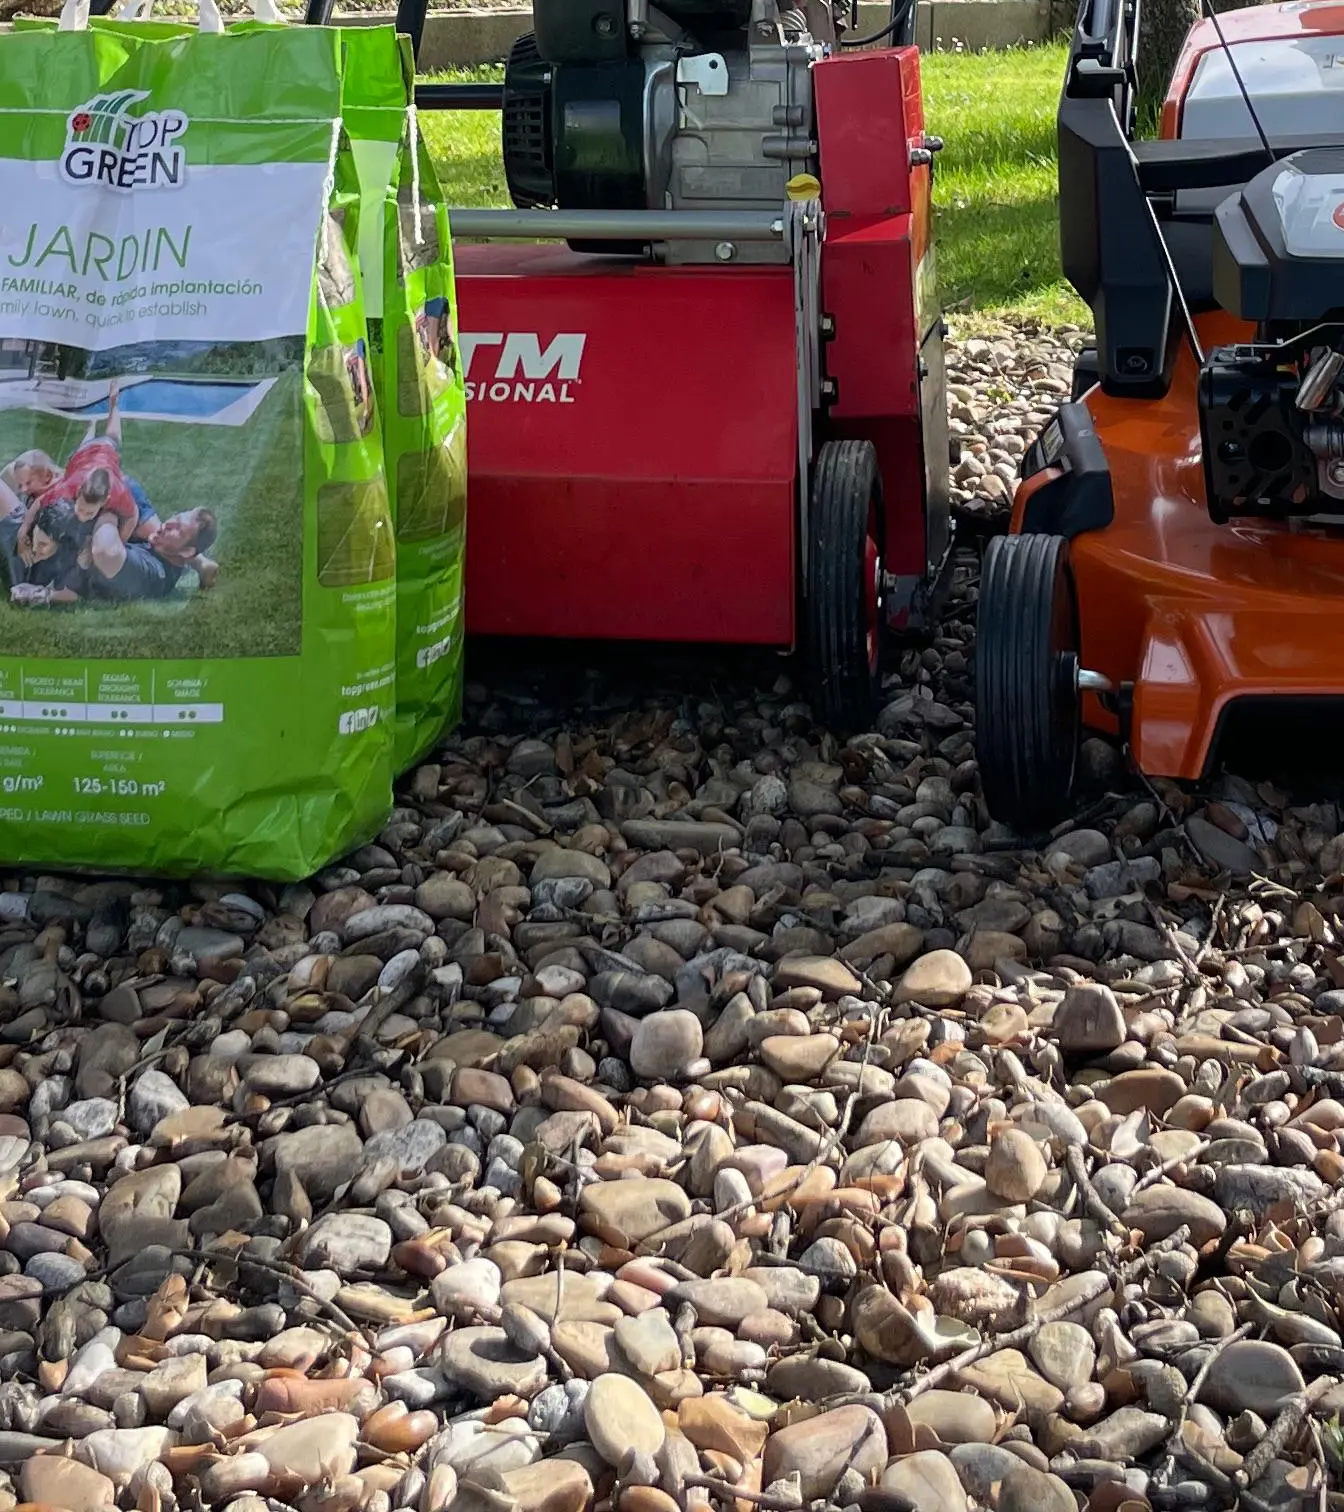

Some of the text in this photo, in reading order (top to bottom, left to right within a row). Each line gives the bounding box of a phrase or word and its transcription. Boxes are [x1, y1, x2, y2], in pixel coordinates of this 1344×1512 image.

[123, 118, 183, 152] TOP
[65, 147, 180, 188] GREEN
[7, 224, 192, 282] JARDIN
[2, 277, 81, 303] FAMILIAR,
[86, 291, 107, 306] de
[34, 300, 79, 323] lawn,
[85, 311, 123, 329] quick
[125, 308, 135, 321] to
[138, 301, 208, 318] establish
[72, 776, 138, 795] 125-150
[34, 809, 73, 823] LAWN
